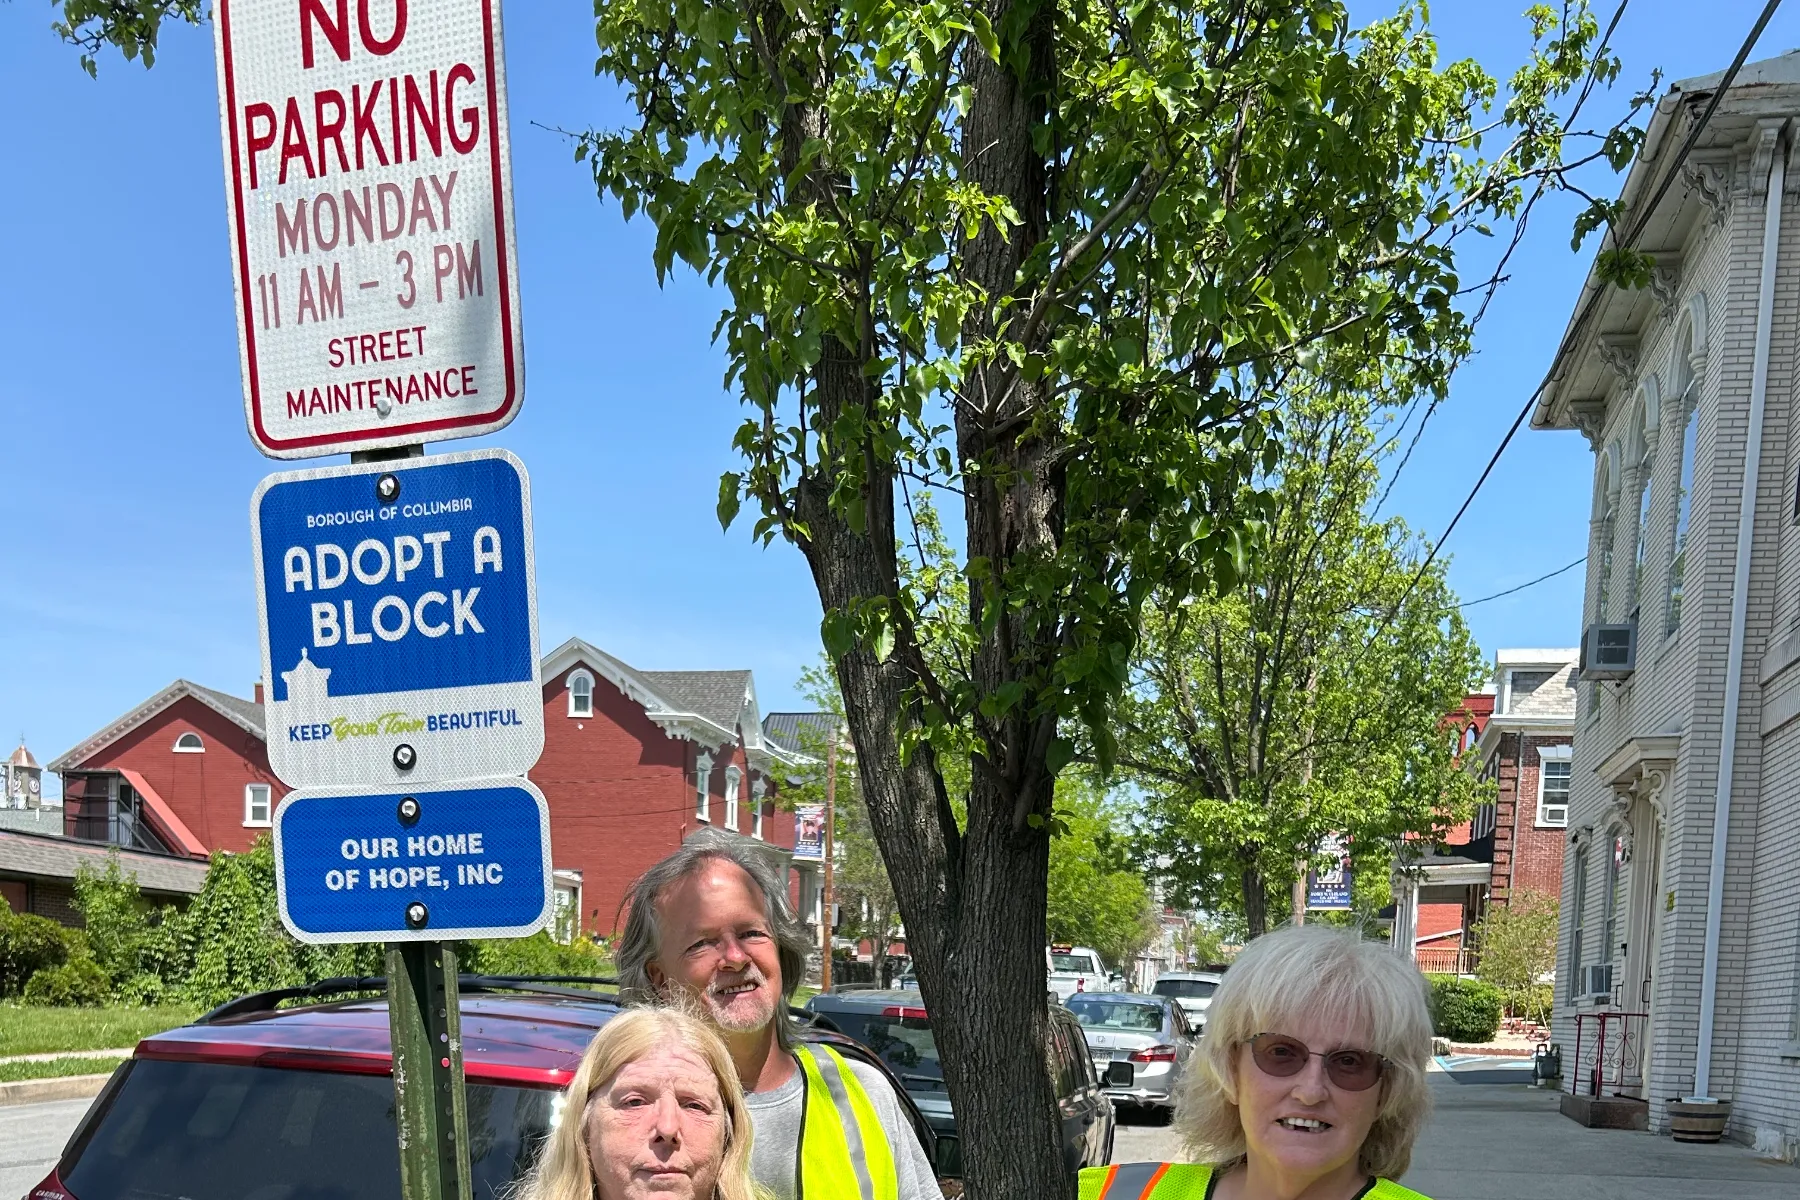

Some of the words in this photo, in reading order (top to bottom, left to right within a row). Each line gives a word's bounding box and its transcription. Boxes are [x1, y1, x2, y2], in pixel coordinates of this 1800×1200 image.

[302, 0, 408, 69] NO
[244, 63, 480, 190] PARKING
[275, 171, 459, 258] MONDAY
[258, 272, 281, 331] 11
[297, 262, 344, 325] AM
[396, 250, 417, 310] 3
[434, 240, 483, 305] PM
[328, 326, 427, 368] STREET
[286, 366, 479, 419] MAINTENANCE
[307, 509, 375, 528] BOROUGH
[379, 506, 398, 521] OF
[402, 497, 472, 518] COLUMBIA
[283, 531, 451, 593] ADOPT
[473, 525, 503, 574] A
[311, 587, 485, 647] BLOCK
[289, 724, 332, 741] KEEP
[427, 708, 522, 732] BEAUTIFUL
[340, 837, 400, 860] OUR
[407, 833, 484, 858] HOME
[325, 869, 360, 891] OF
[369, 866, 449, 891] HOPE,
[457, 863, 503, 886] INC
